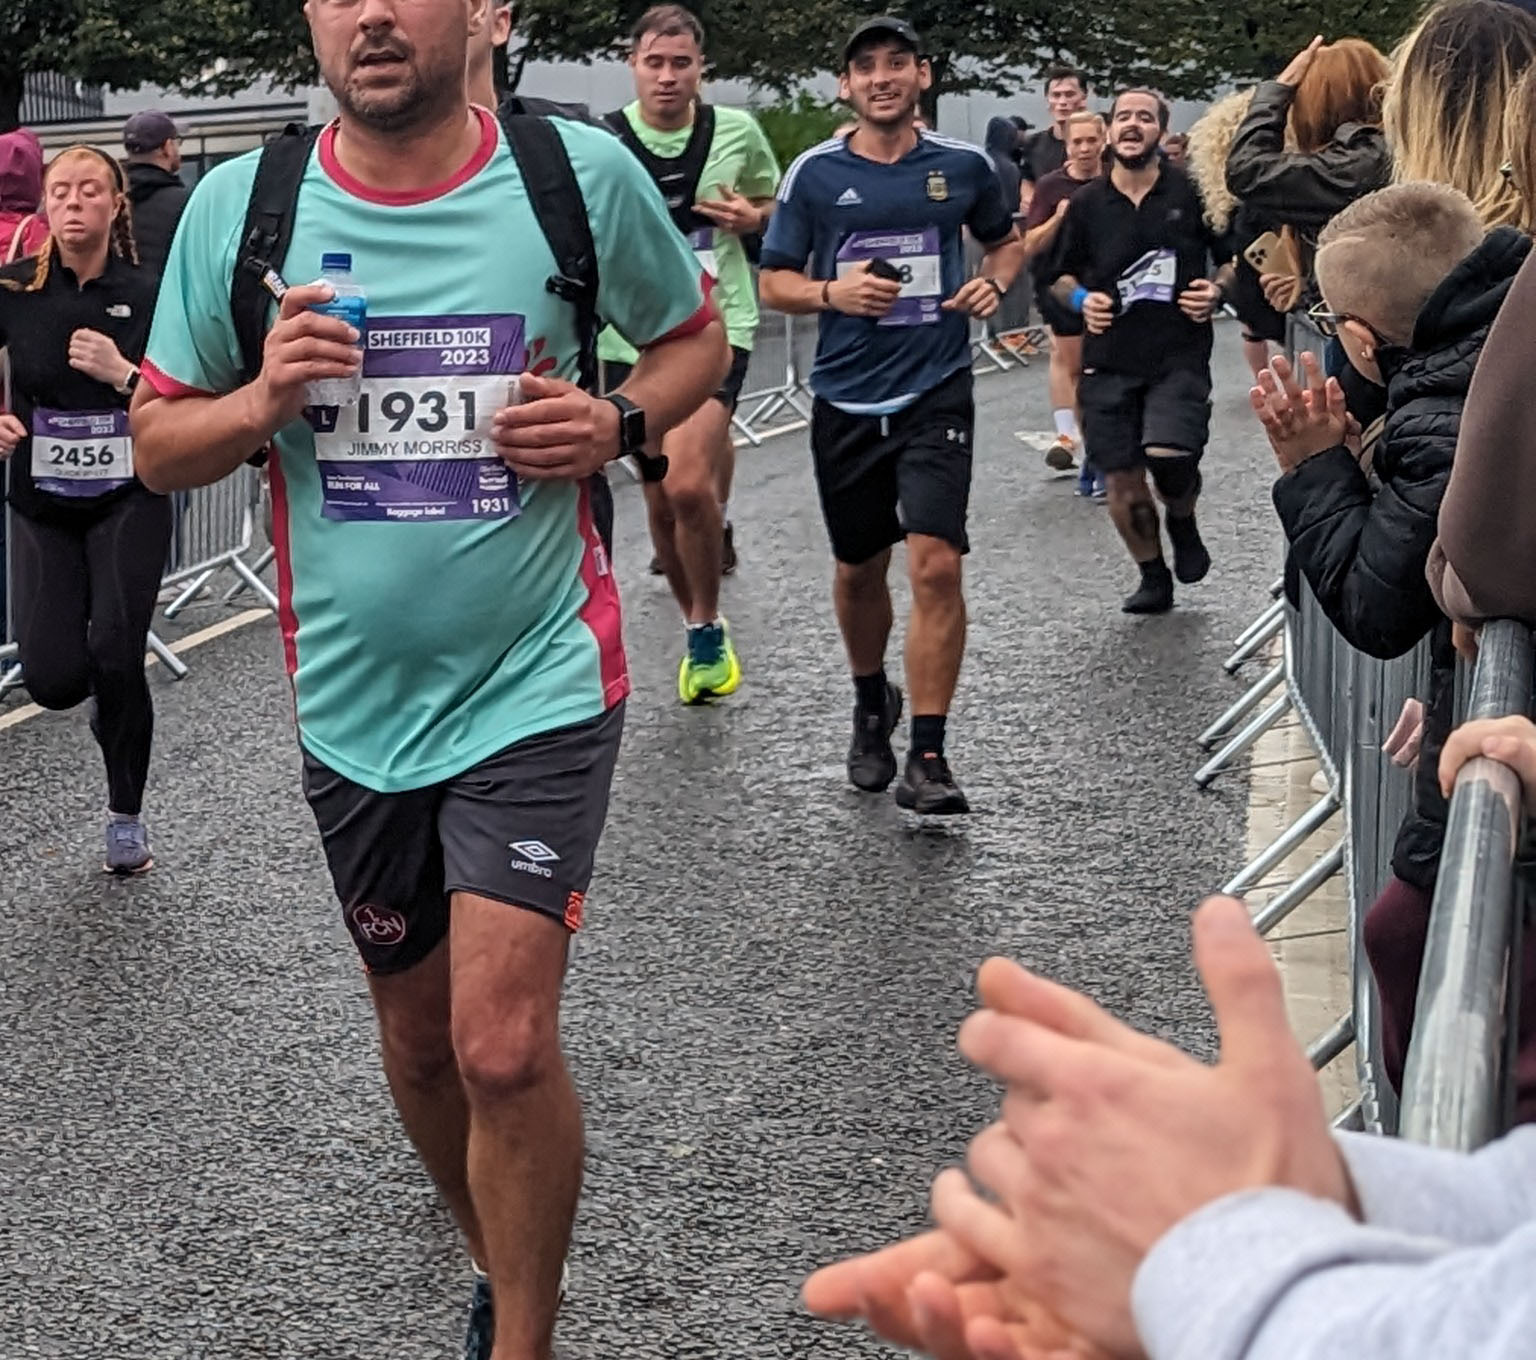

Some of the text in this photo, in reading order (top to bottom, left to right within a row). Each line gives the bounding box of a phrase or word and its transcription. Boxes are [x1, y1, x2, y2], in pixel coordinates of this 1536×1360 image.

[369, 329, 487, 348] SHEFFIELD 10K
[440, 349, 490, 366] 2023
[358, 390, 476, 433] 1931
[49, 444, 114, 467] 2456
[347, 439, 482, 457] JIMMY MORRISS
[471, 497, 510, 514] 1931
[511, 859, 553, 879] umbro
[362, 916, 402, 939] FCN
